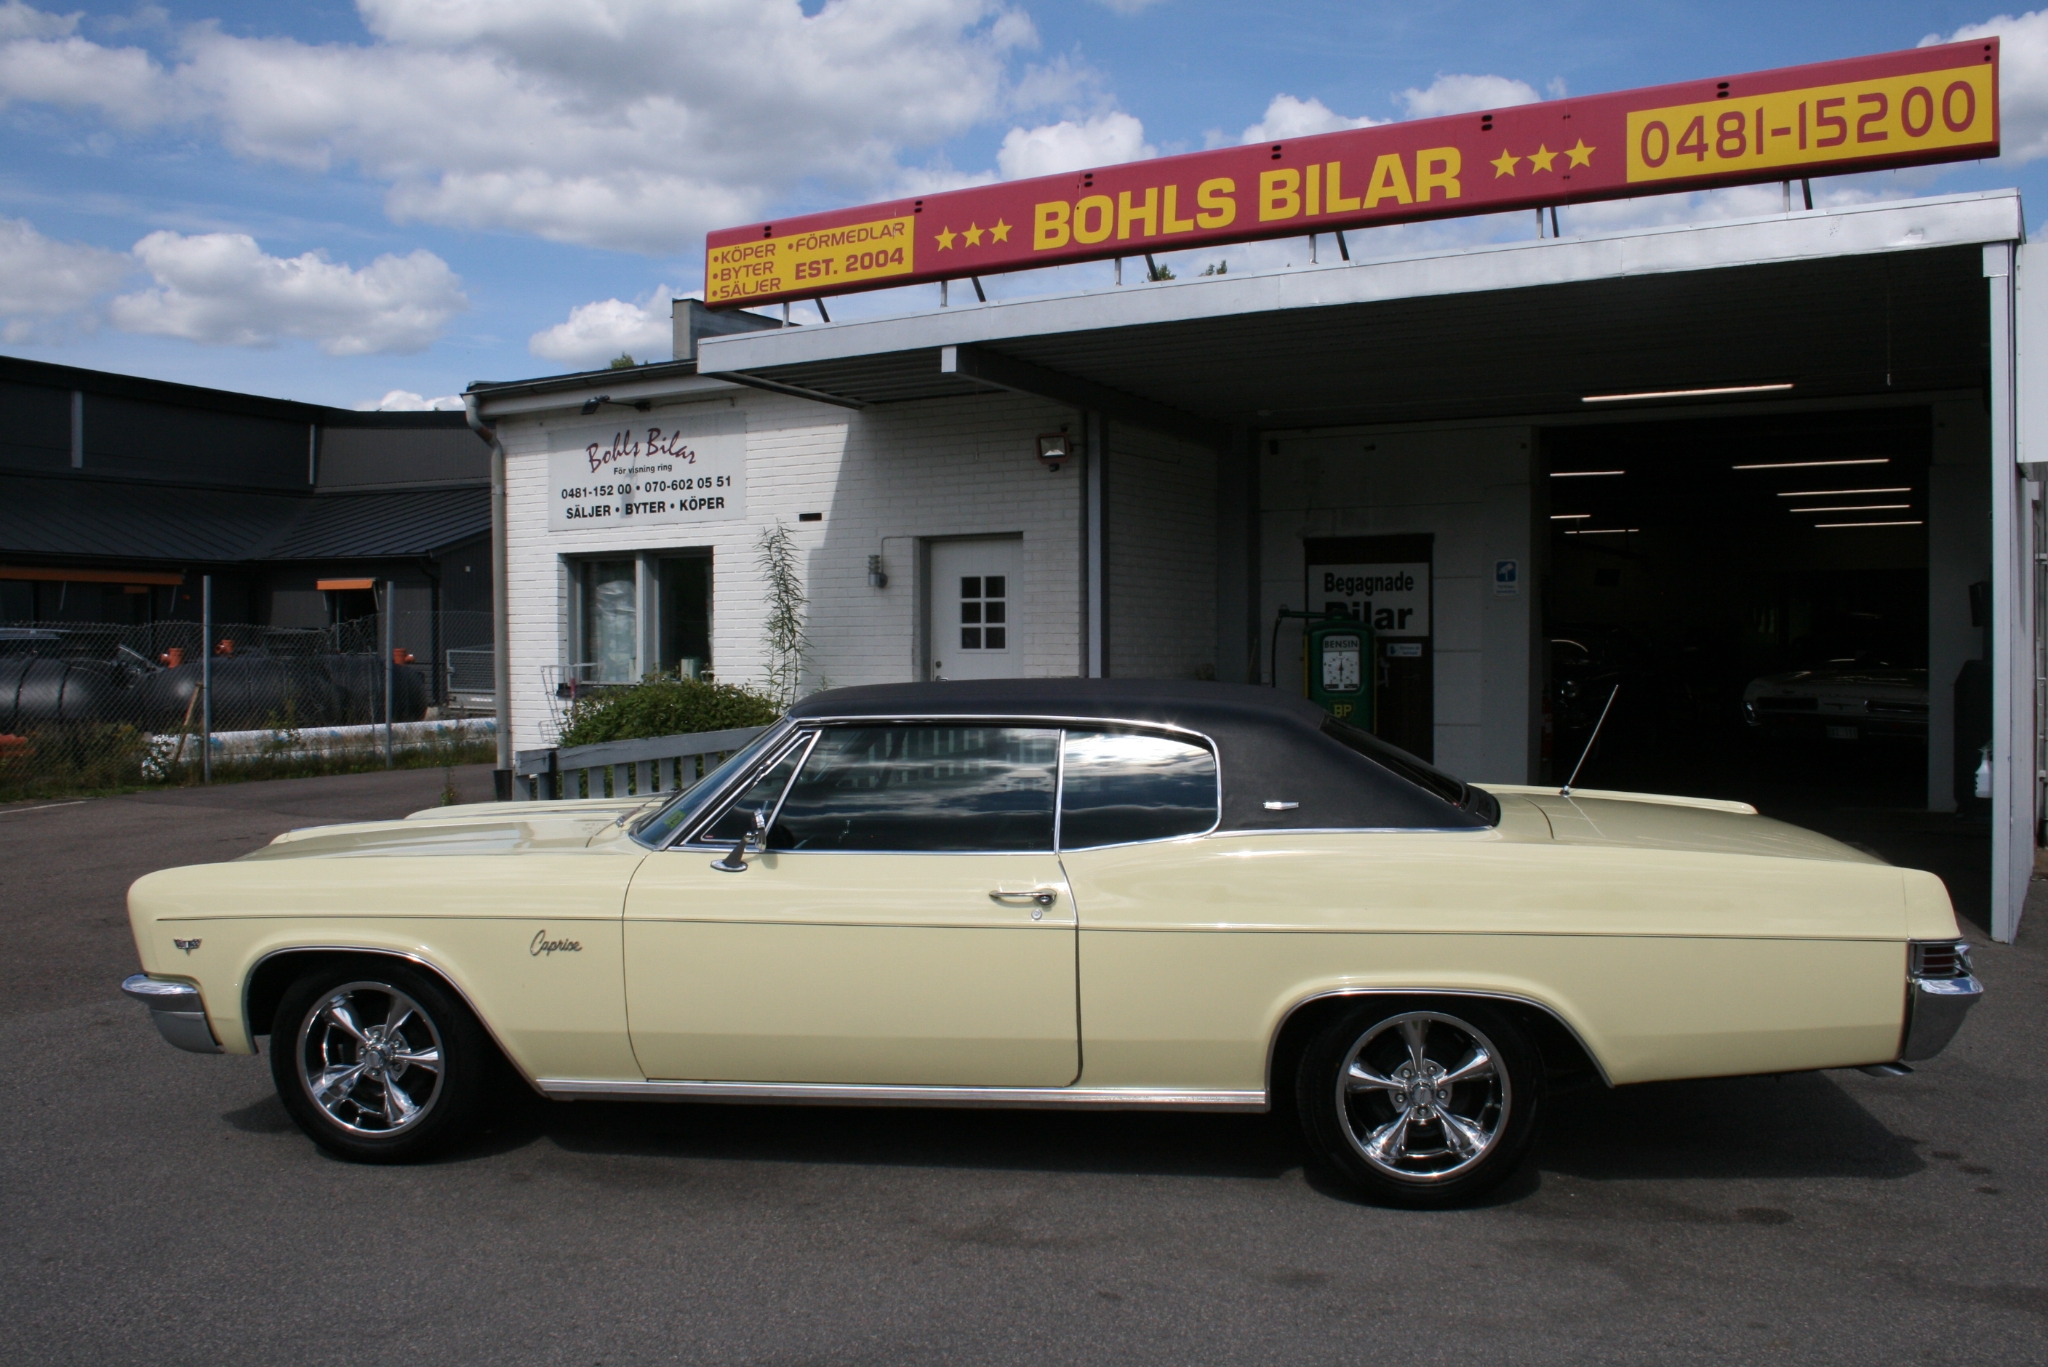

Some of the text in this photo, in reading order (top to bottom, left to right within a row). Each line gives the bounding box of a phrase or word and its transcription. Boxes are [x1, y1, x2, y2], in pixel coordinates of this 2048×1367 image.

[1641, 80, 1976, 168] 0481-15200
[1033, 146, 1462, 251] BOHLS BILAR
[795, 222, 905, 252] FÖRMEDLAR
[720, 243, 776, 264] KÖPER
[795, 247, 904, 281] EST. 2004
[720, 261, 774, 282] BYTER
[719, 278, 781, 299] SÄLJER
[586, 427, 697, 473] Bohls Bilar
[613, 463, 673, 475] För visning ring
[561, 475, 731, 499] 0481-152 00 070-602 05 51
[566, 496, 725, 519] SÄLJER BYTER KÖPER
[1324, 571, 1414, 596] Begagnade
[1324, 640, 1358, 649] BENSIN
[1333, 704, 1352, 718] BP
[530, 929, 583, 957] Caprice
